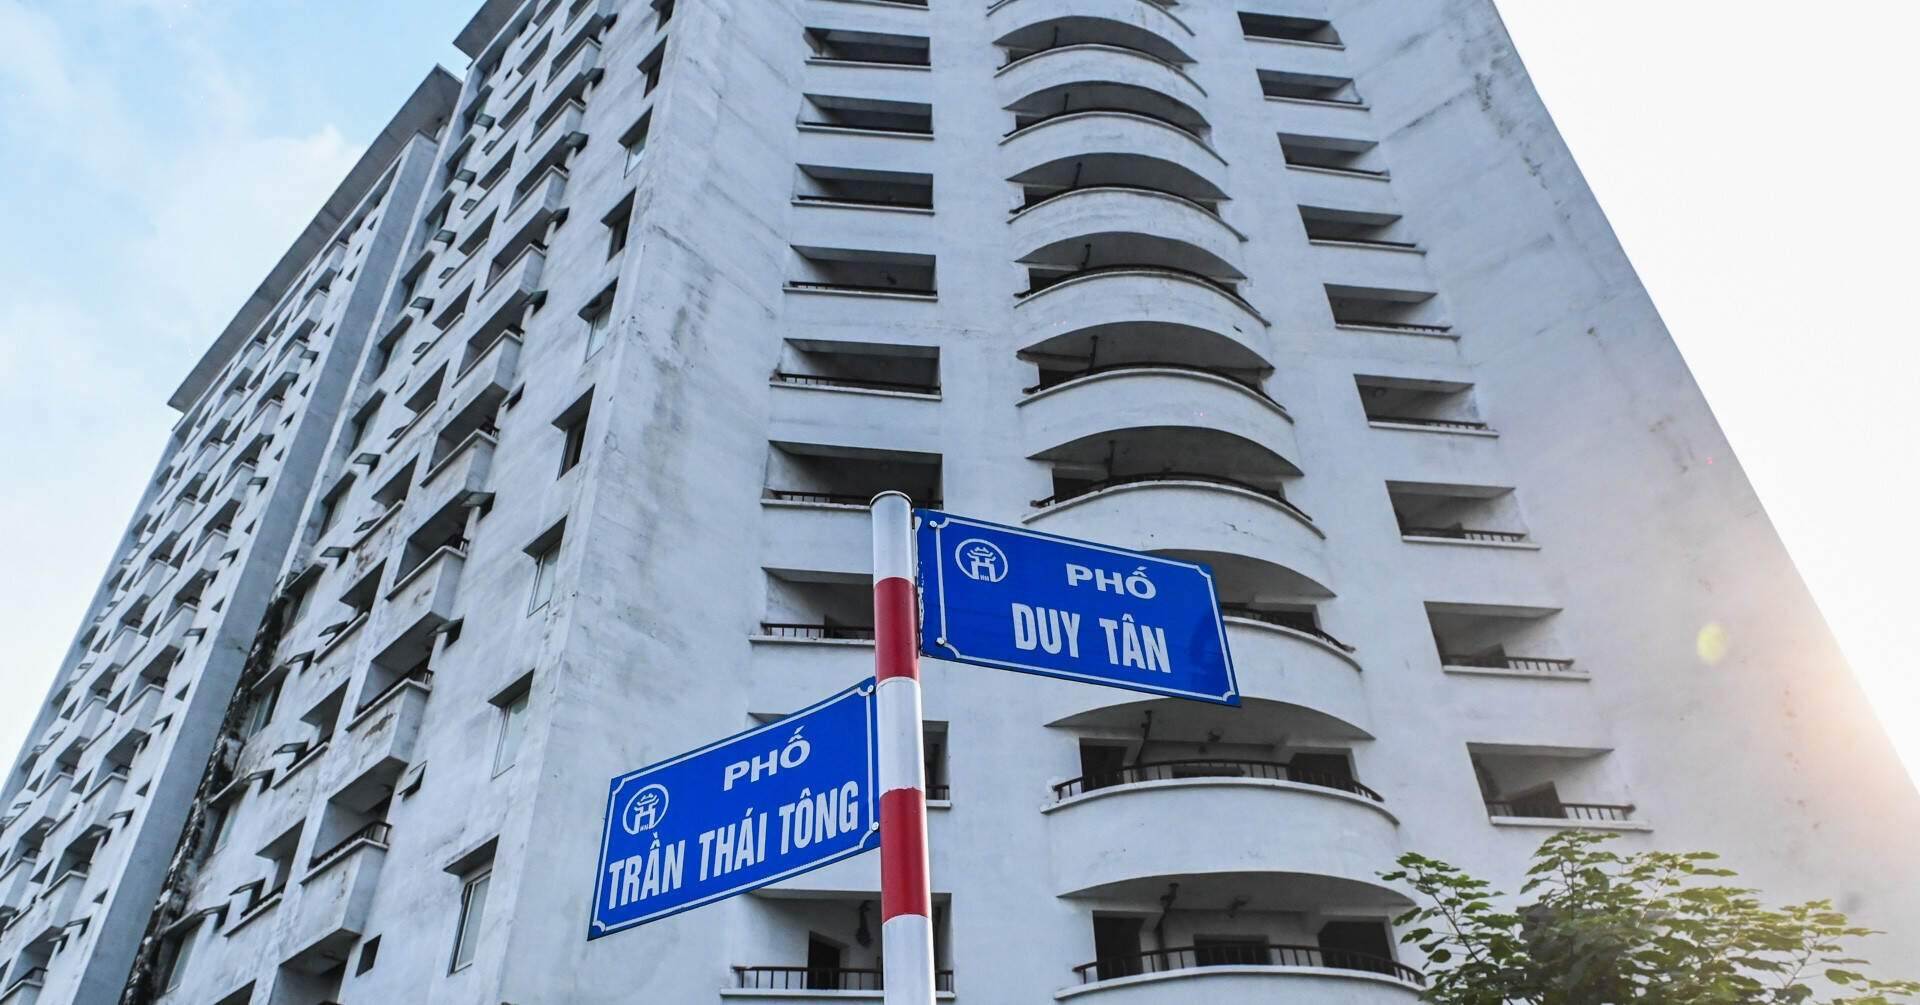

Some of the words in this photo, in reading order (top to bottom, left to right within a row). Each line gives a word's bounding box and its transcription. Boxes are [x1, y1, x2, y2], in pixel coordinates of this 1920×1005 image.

[1066, 563, 1157, 600] PHỐ
[1011, 602, 1081, 658] DUY
[1098, 613, 1171, 673] TÂN
[723, 725, 811, 792] PHỐ
[608, 831, 686, 910] TRẦN
[698, 807, 768, 882] THÁI
[778, 780, 859, 855] TÔNG
